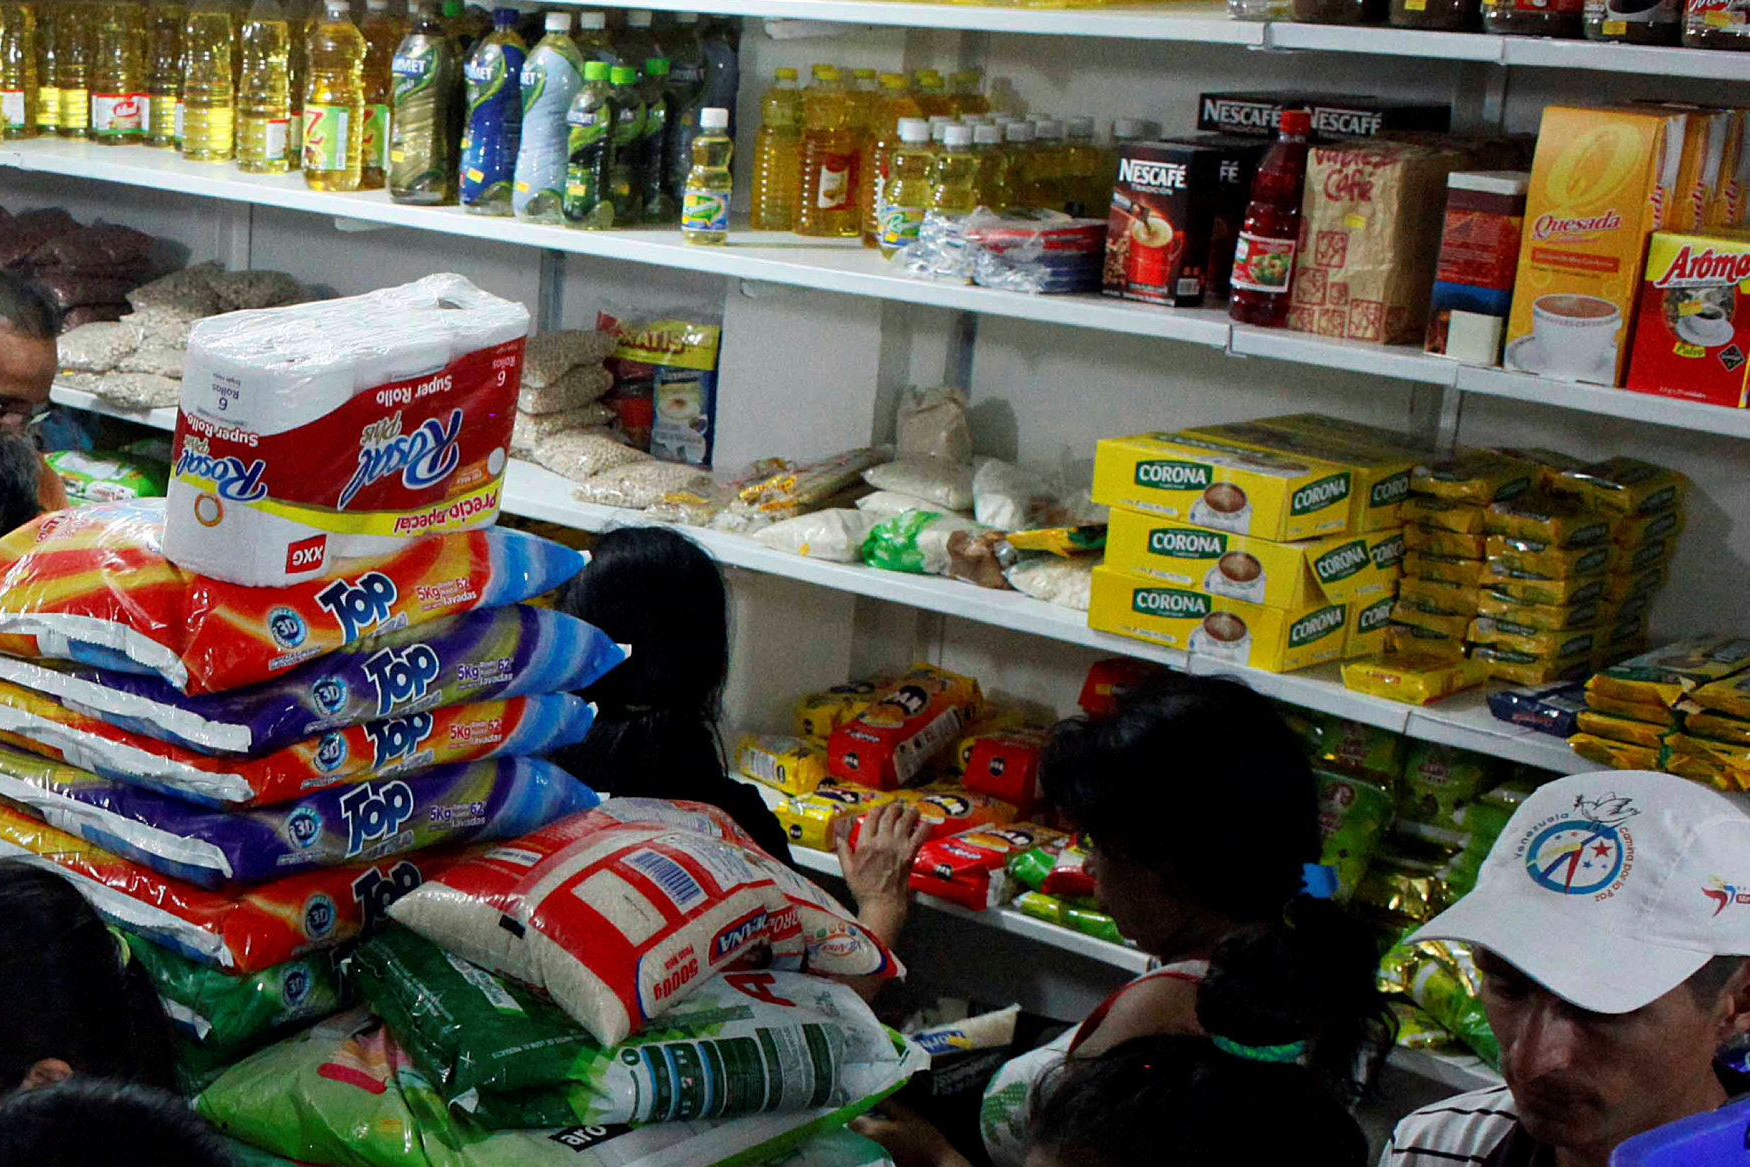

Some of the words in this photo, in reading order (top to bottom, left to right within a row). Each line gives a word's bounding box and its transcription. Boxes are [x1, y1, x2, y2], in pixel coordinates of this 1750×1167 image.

[1119, 158, 1188, 189] NESCAFÉ
[1533, 208, 1622, 240] Quesada
[413, 374, 454, 399] Super
[496, 371, 507, 389] 6
[218, 396, 229, 412] 6
[376, 387, 411, 408] Rollo
[186, 413, 216, 440] Rollo
[215, 424, 260, 449] Super
[337, 408, 464, 513] Rosal
[175, 447, 269, 503] Rosal
[1138, 464, 1207, 486] CORONA
[1371, 475, 1410, 503] CORO
[1292, 480, 1347, 510] CORONA
[291, 545, 325, 568] XXG
[1151, 532, 1222, 554] CORONA
[1316, 545, 1368, 579] CORONA
[314, 571, 398, 645] Top
[1136, 592, 1206, 613] CORONA
[1291, 605, 1343, 641] CORONA
[361, 643, 440, 717] Top
[339, 780, 414, 860] Top
